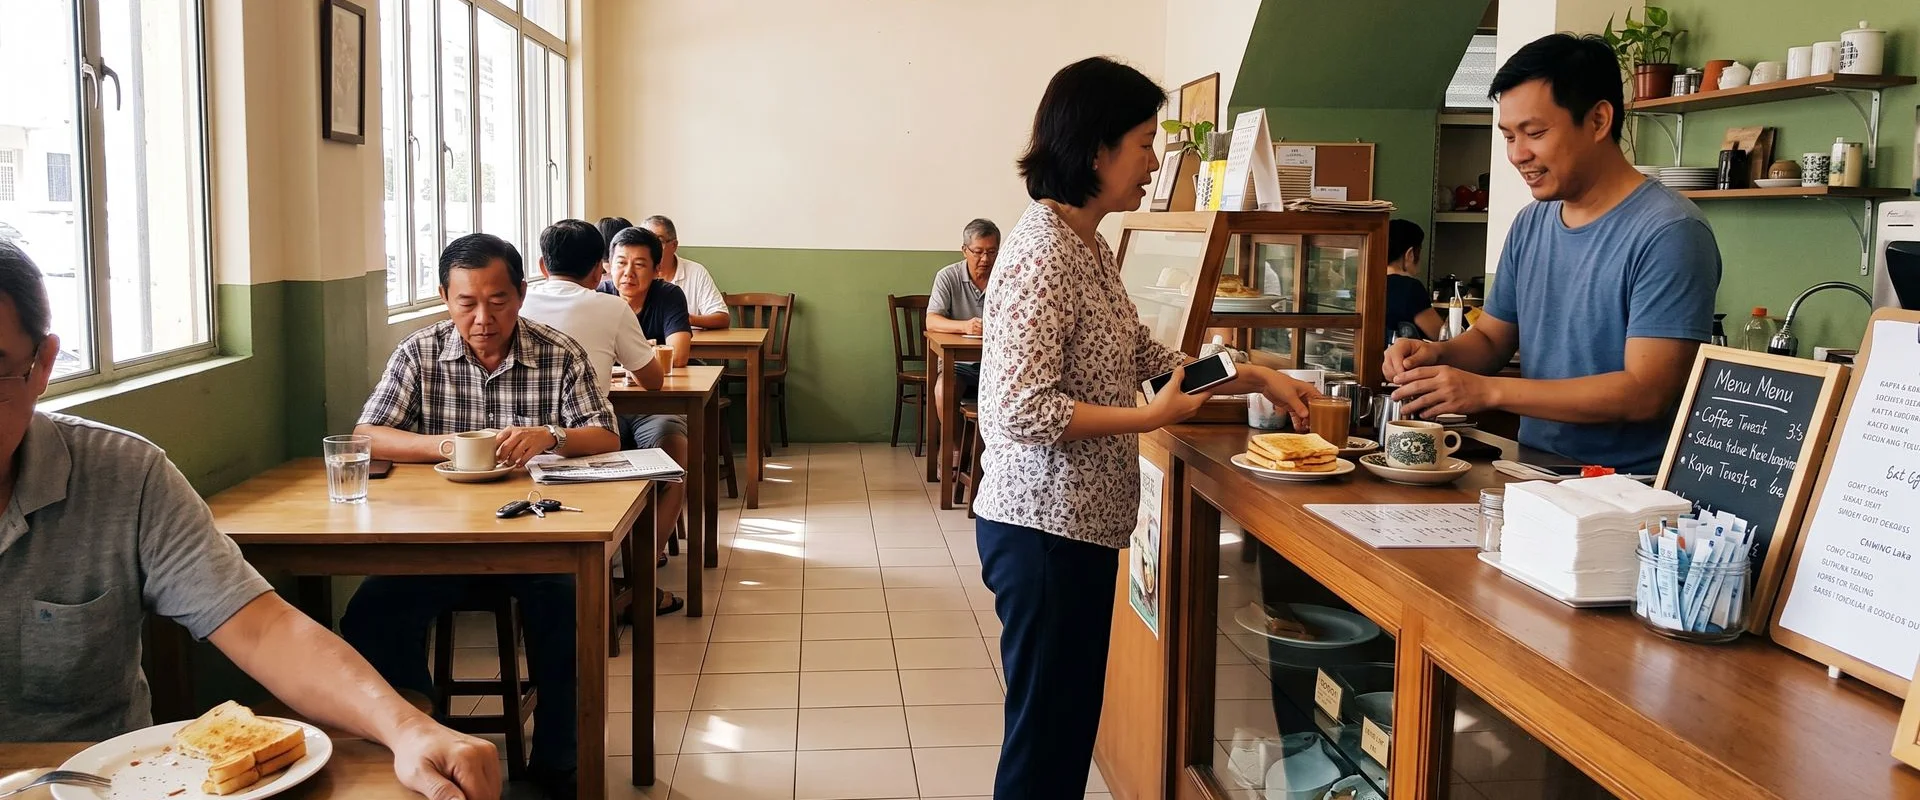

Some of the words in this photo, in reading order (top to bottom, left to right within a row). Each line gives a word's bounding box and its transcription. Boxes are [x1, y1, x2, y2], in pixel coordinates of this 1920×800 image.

[1714, 369, 1751, 394] Menu
[1755, 375, 1794, 403] Menu
[1701, 406, 1734, 429] Coffee
[1687, 454, 1713, 482] Kaya
